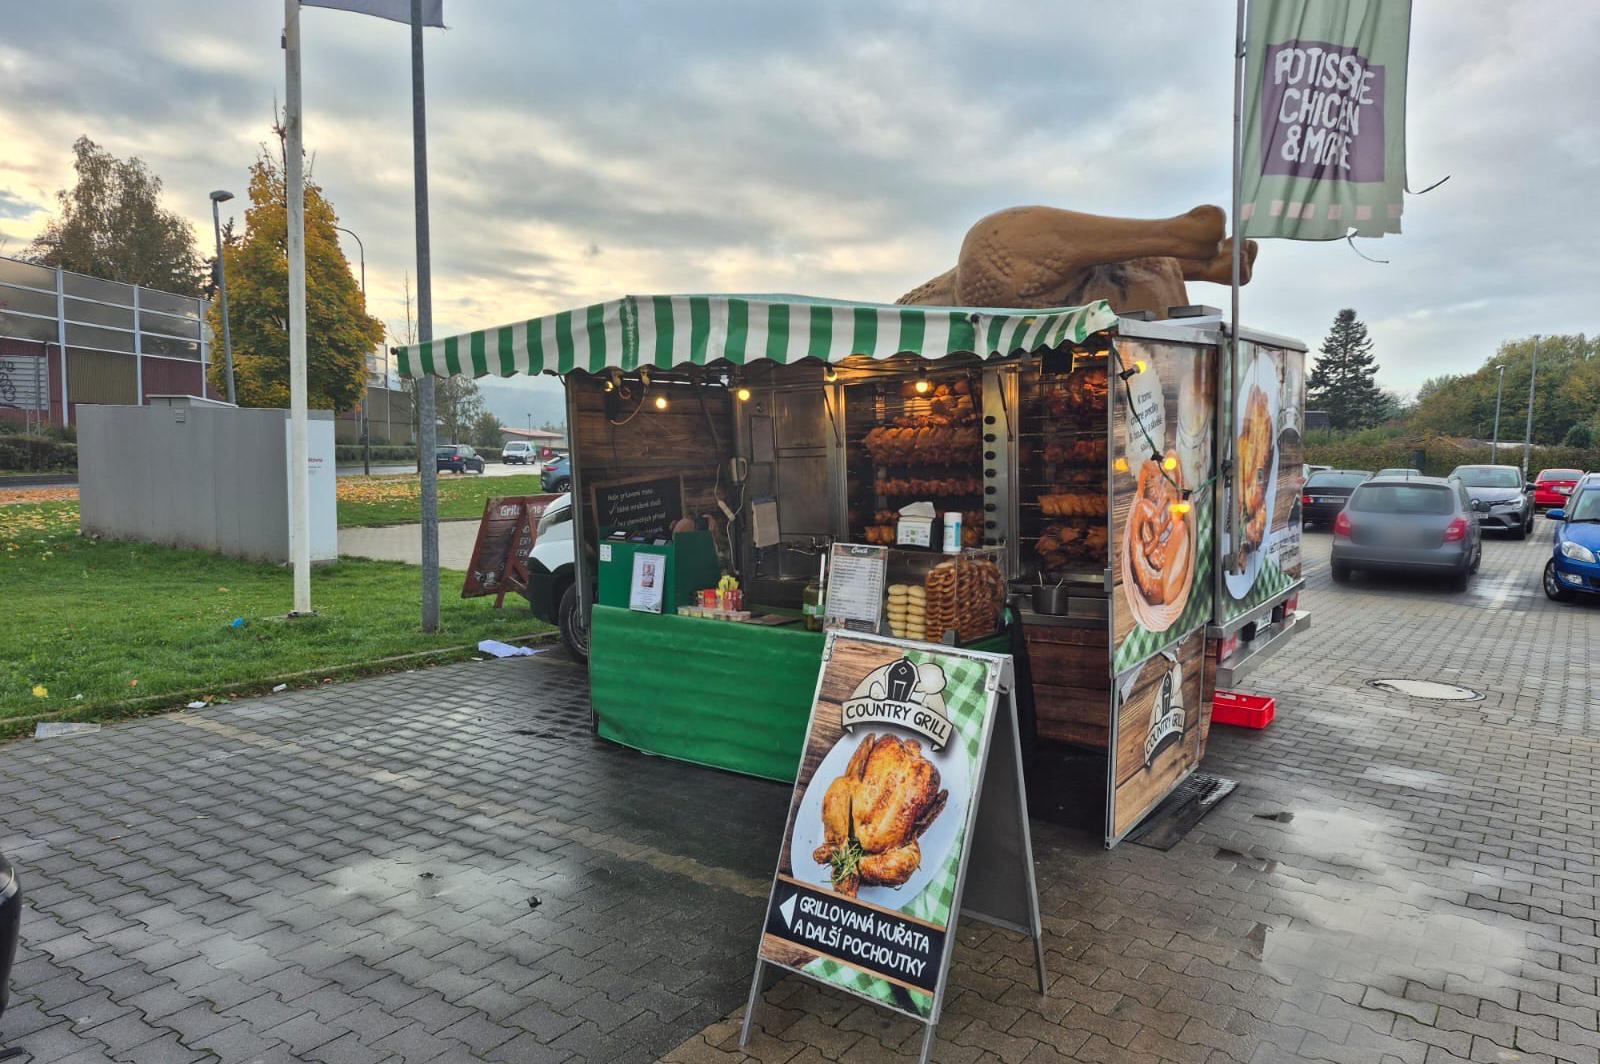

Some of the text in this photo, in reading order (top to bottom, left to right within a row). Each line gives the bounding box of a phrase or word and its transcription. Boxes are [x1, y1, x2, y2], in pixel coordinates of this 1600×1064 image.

[846, 703, 946, 740] COUNTRY GRILL
[1146, 713, 1183, 754] COUNTRY GRILL
[794, 919, 927, 978] A DALŠÍ POCHOUTKY
[799, 896, 930, 954] GRILLOVANÁ KUŘATA
